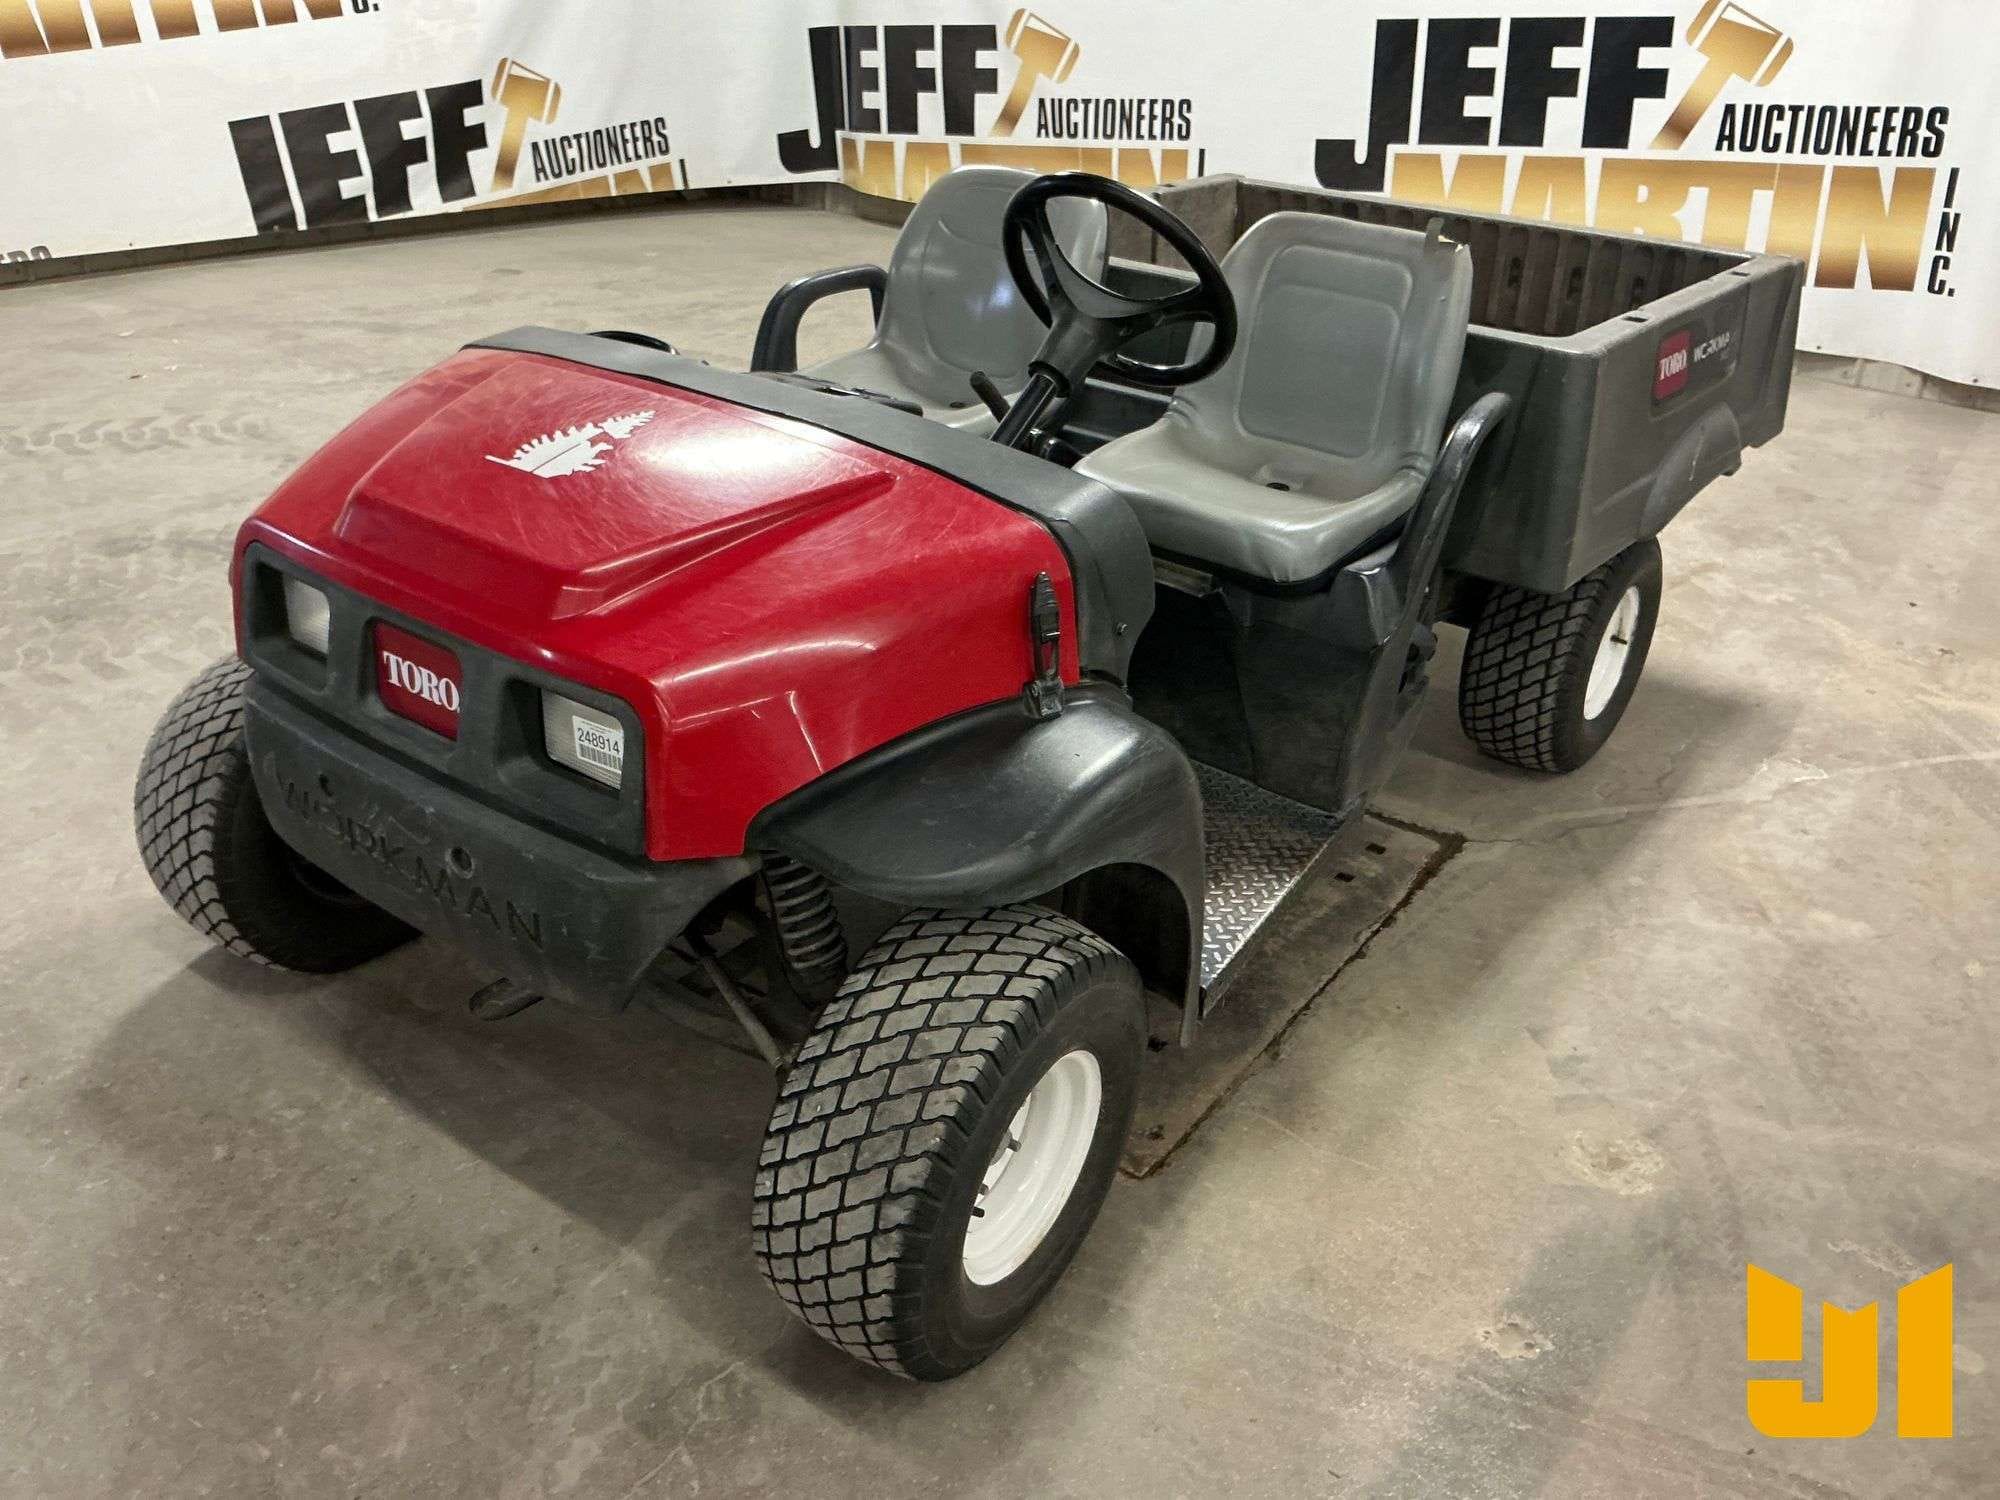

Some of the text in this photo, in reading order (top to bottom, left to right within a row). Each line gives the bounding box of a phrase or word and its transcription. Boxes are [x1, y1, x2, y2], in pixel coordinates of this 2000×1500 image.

[778, 25, 998, 174] JEFF
[1037, 98, 1191, 141] AUCTIONEERS
[1314, 16, 1674, 191] JEFF
[532, 117, 670, 182] AUCTIONEERS
[1715, 103, 1949, 157] AUCTIONEERS
[1658, 349, 1688, 381] TORO
[383, 650, 460, 711] TORO
[577, 727, 621, 754] 248914
